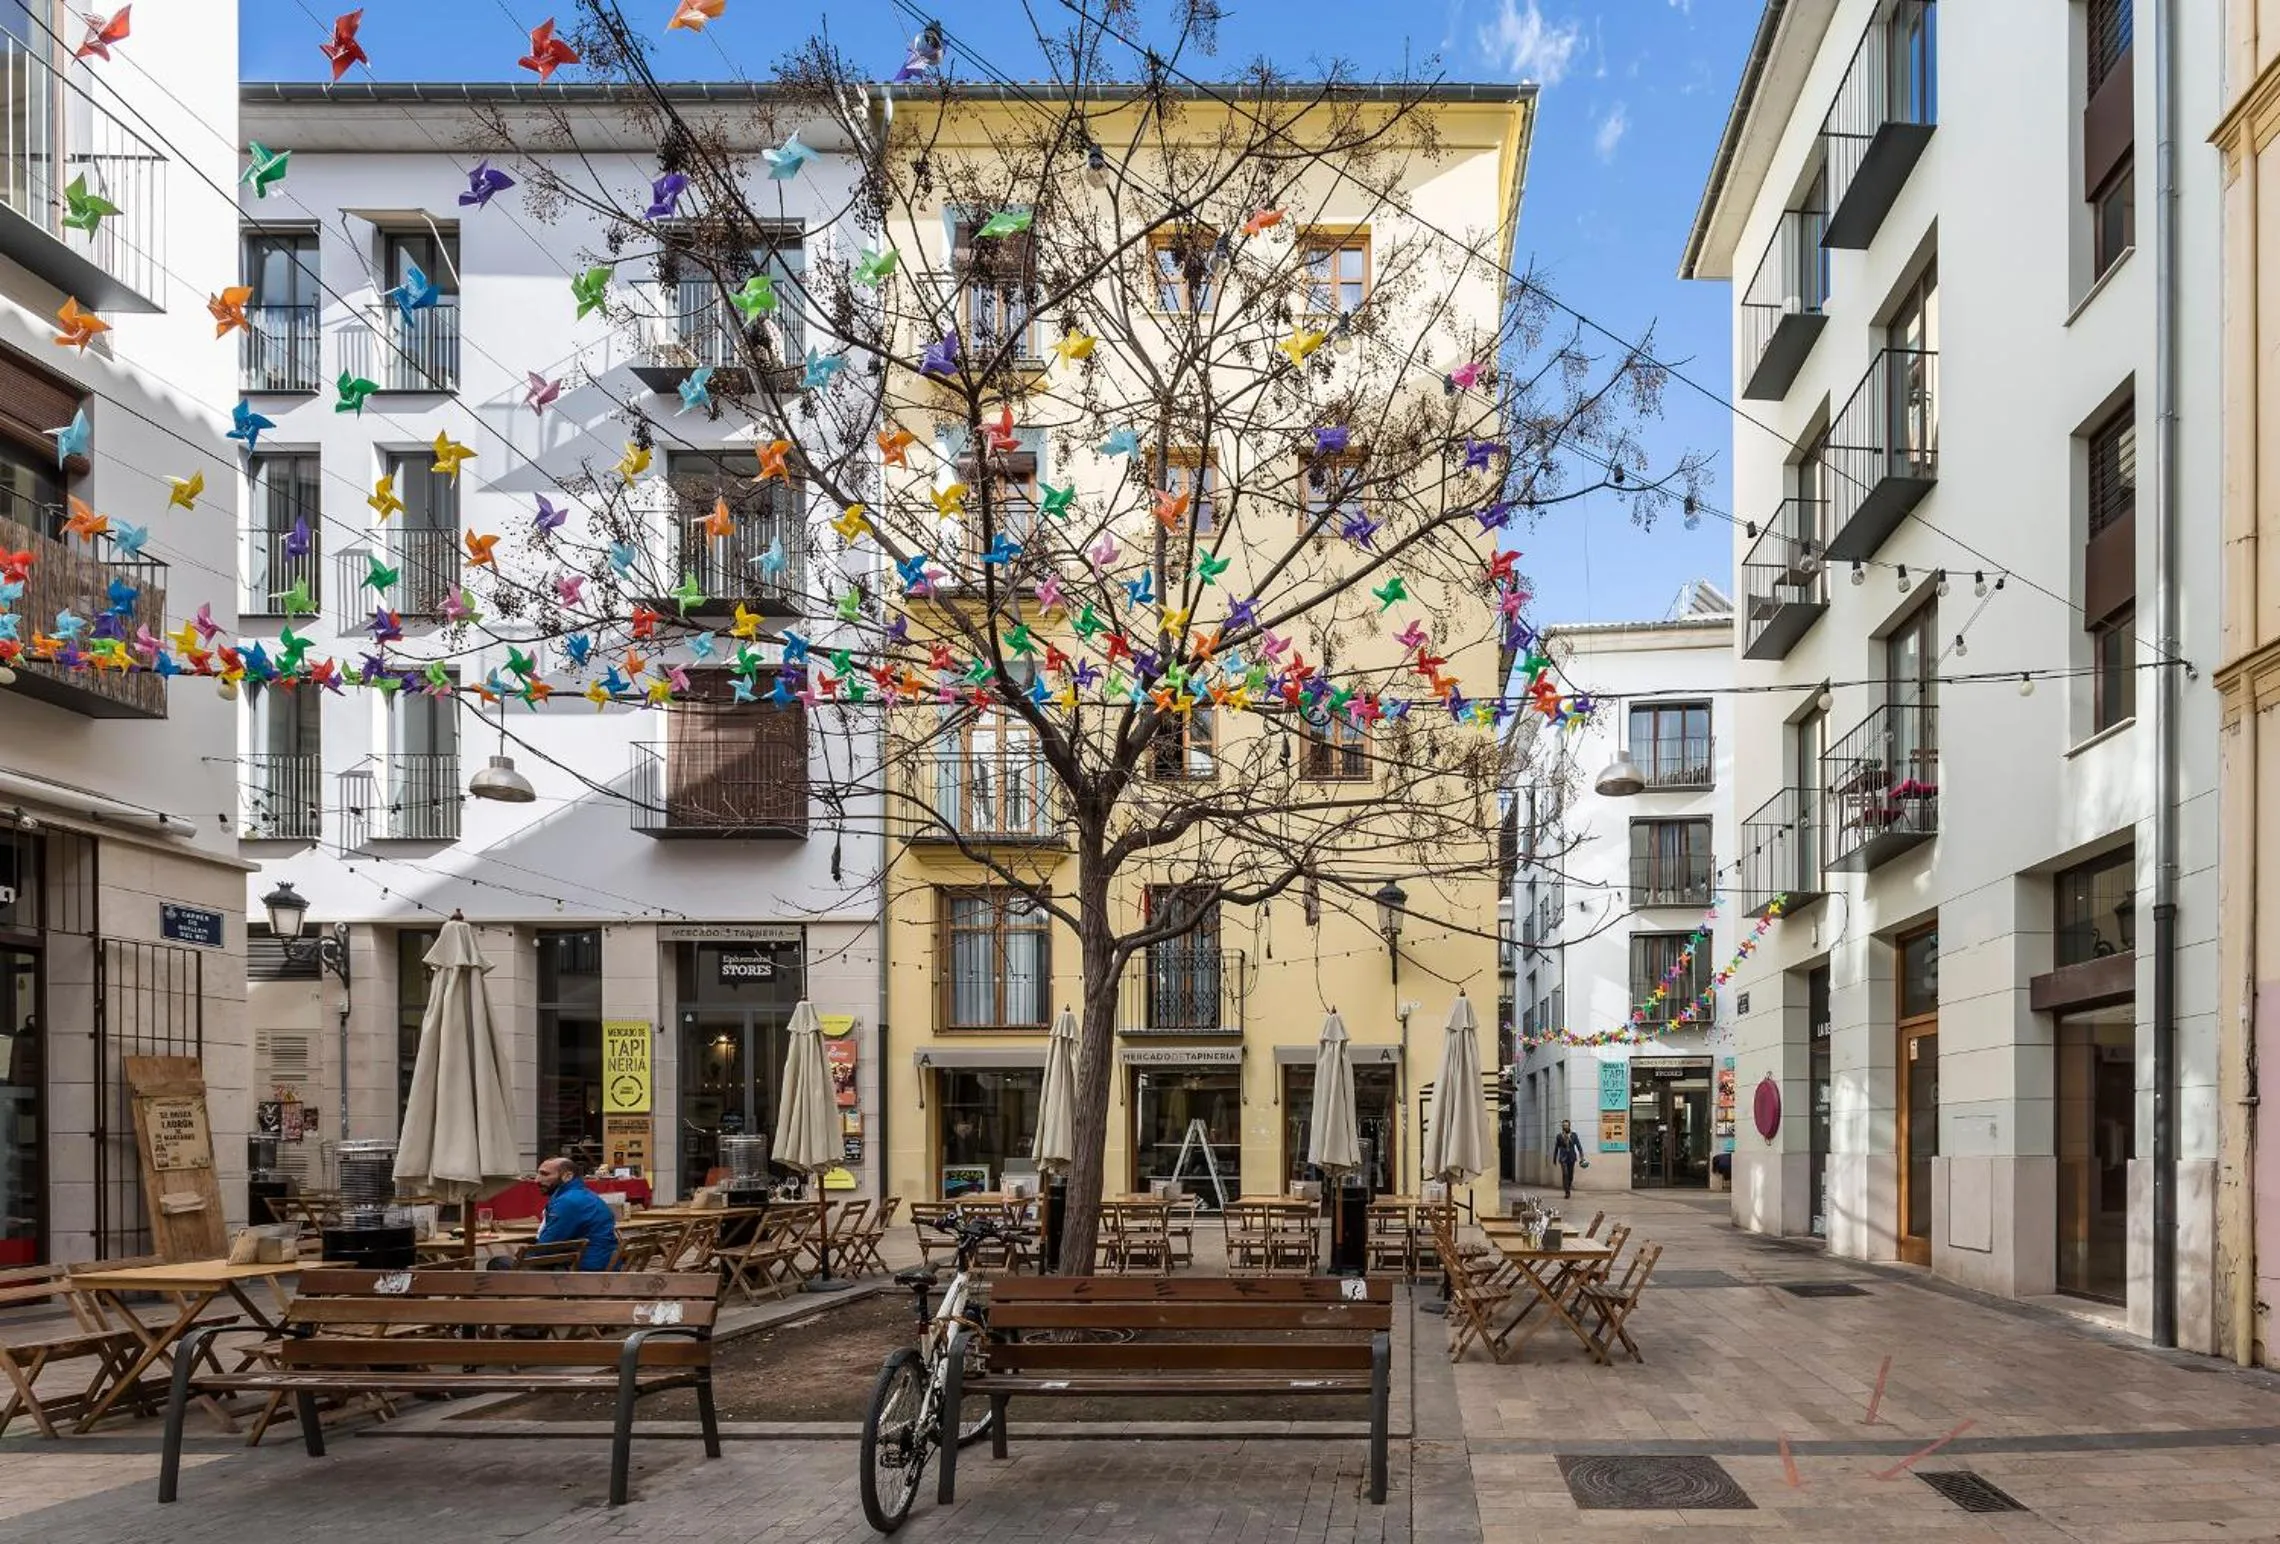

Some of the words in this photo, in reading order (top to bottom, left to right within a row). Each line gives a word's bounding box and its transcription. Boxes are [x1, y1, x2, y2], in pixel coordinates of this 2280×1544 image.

[671, 929, 720, 937] MERCADO
[733, 929, 784, 938] TAPINERIA
[722, 965, 772, 976] STORES
[608, 1028, 637, 1037] MERCADO
[638, 1028, 646, 1037] DE
[609, 1039, 646, 1057] TAPI
[920, 1053, 931, 1066] A
[1122, 1052, 1171, 1061] MERCADO
[1185, 1052, 1236, 1061] TAPINERIA
[1380, 1050, 1391, 1061] A
[607, 1058, 647, 1073] NERIA
